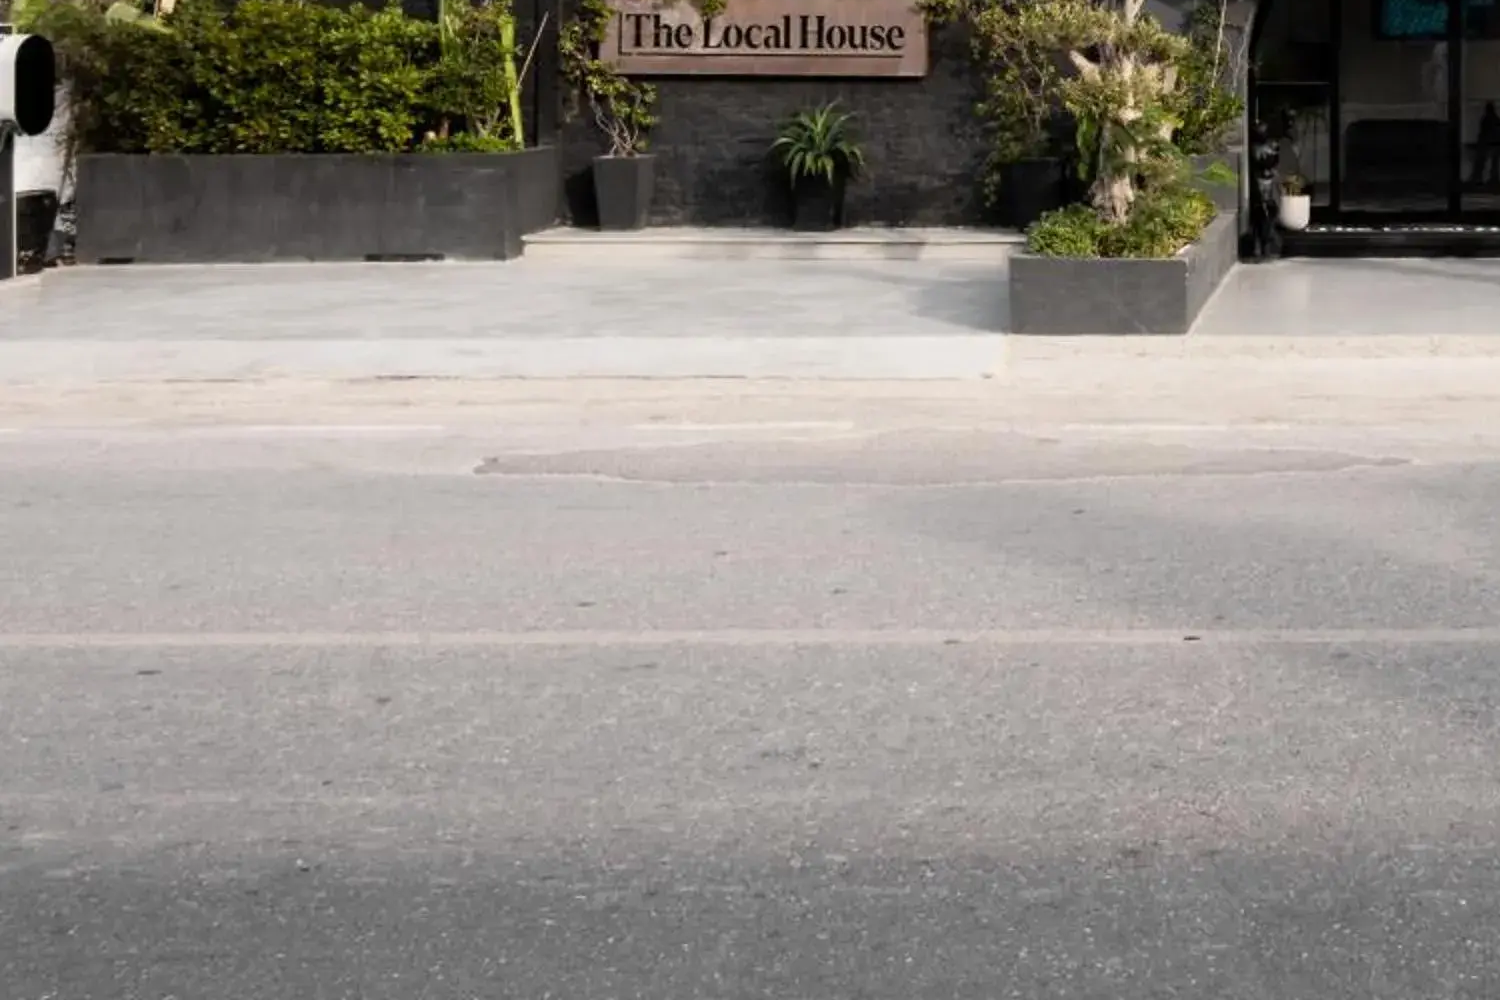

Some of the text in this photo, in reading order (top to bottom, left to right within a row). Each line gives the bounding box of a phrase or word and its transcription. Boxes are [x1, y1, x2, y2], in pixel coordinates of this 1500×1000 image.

[626, 13, 905, 50] The Local House
